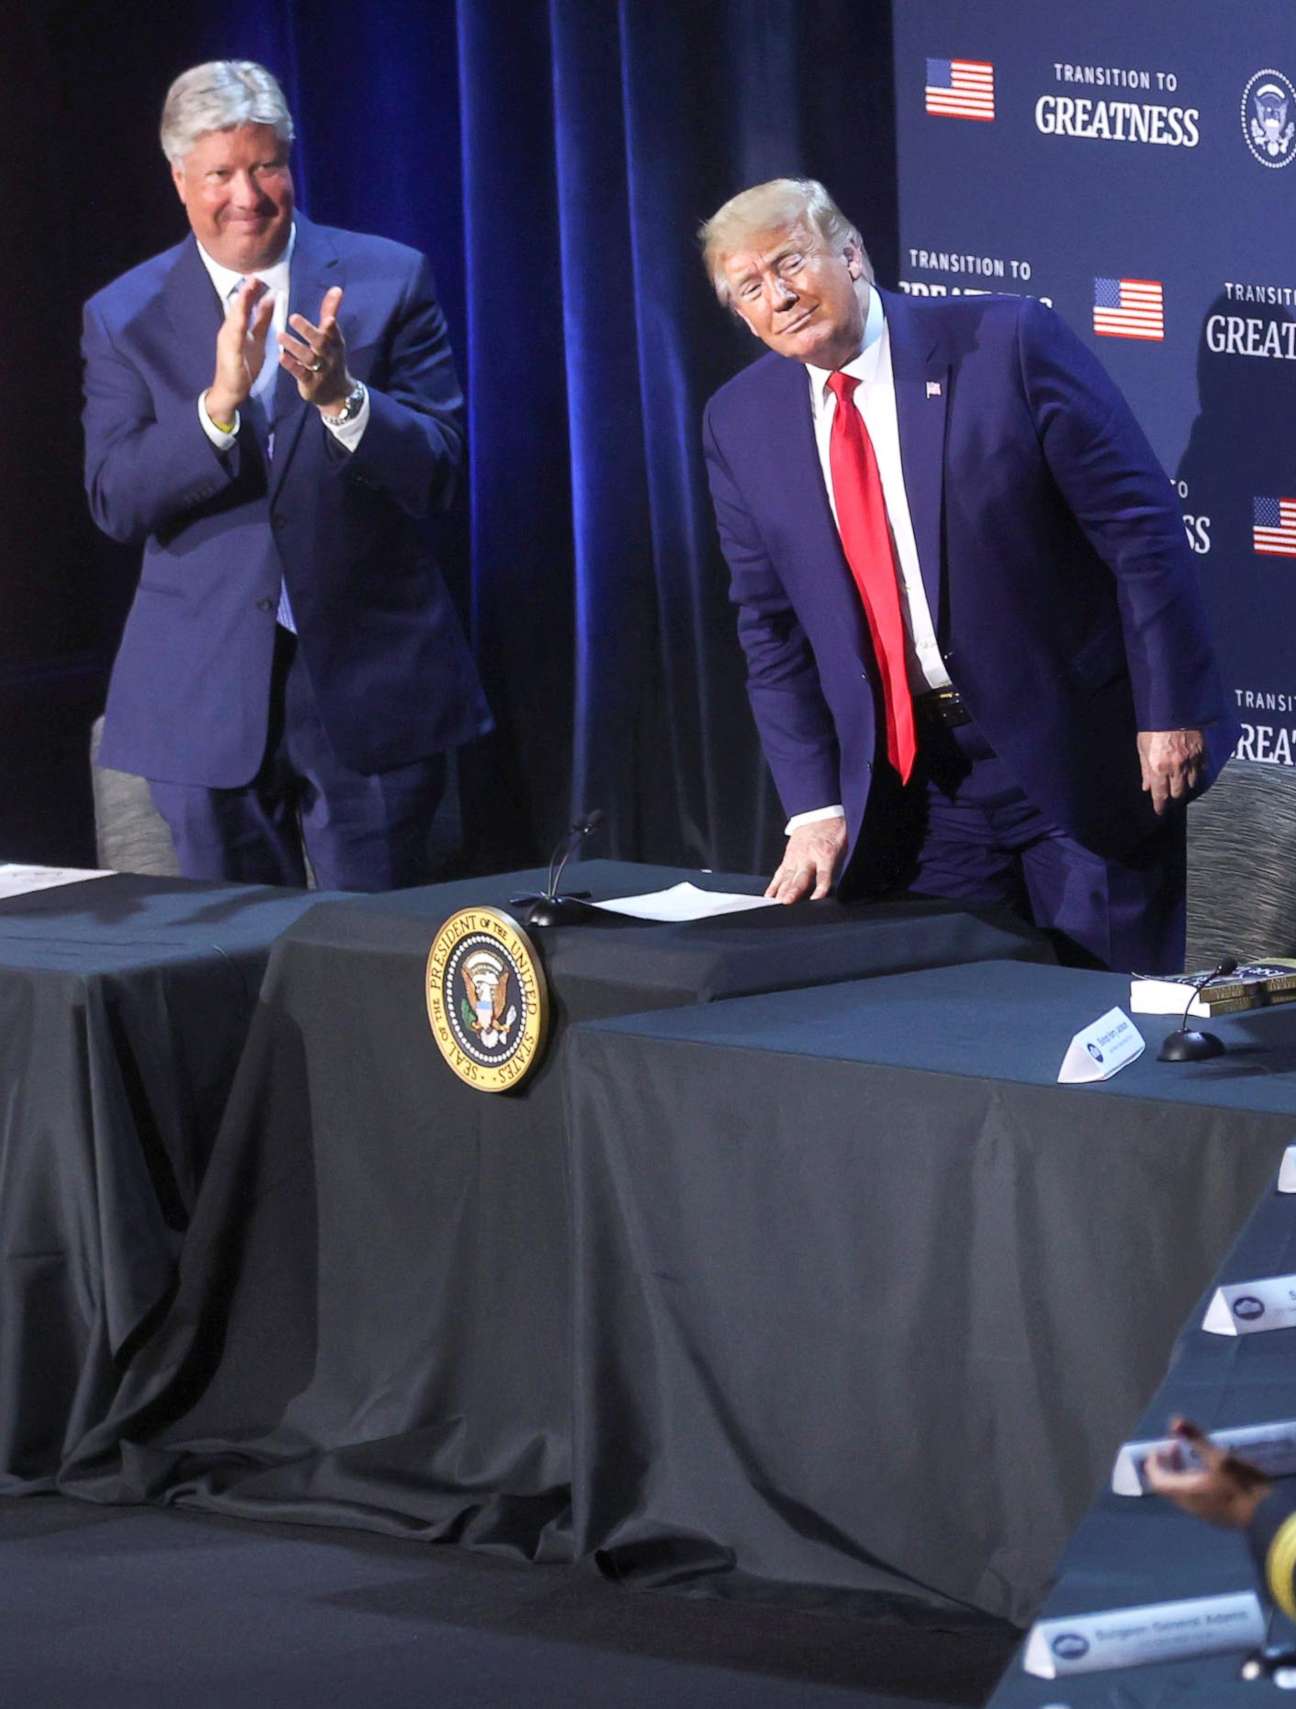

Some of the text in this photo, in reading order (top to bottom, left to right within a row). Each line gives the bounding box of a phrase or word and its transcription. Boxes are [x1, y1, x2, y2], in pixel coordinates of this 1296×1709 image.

[1053, 63, 1178, 92] TRANSITION TO
[1034, 94, 1200, 148] GREATNESS
[909, 248, 1032, 281] TRANSITION TO
[430, 914, 477, 991] PRESIDENT
[510, 942, 538, 1016] UNITED
[499, 1031, 534, 1084] STATES
